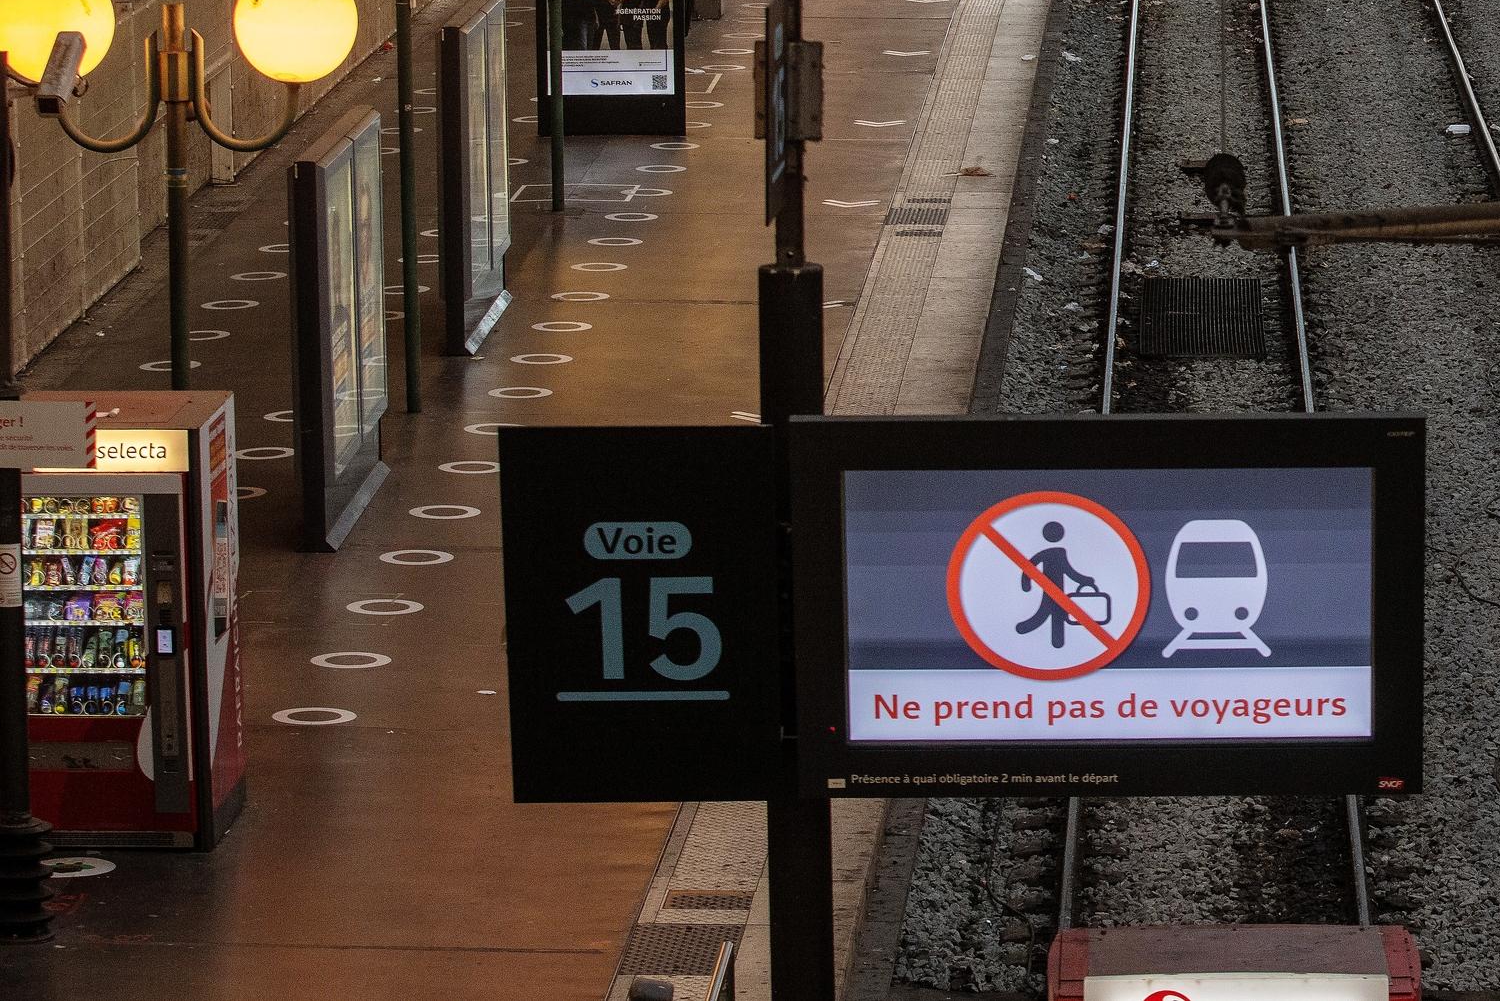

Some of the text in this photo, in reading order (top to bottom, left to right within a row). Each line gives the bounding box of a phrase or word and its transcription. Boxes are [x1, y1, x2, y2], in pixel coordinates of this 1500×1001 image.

[96, 442, 167, 459] selecta
[597, 527, 678, 555] Voie
[563, 576, 723, 681] 15
[874, 692, 1348, 726] Ne prend pas de voyageurs
[851, 773, 1119, 786] Présence à quai obligatoire 2 min avant le départ
